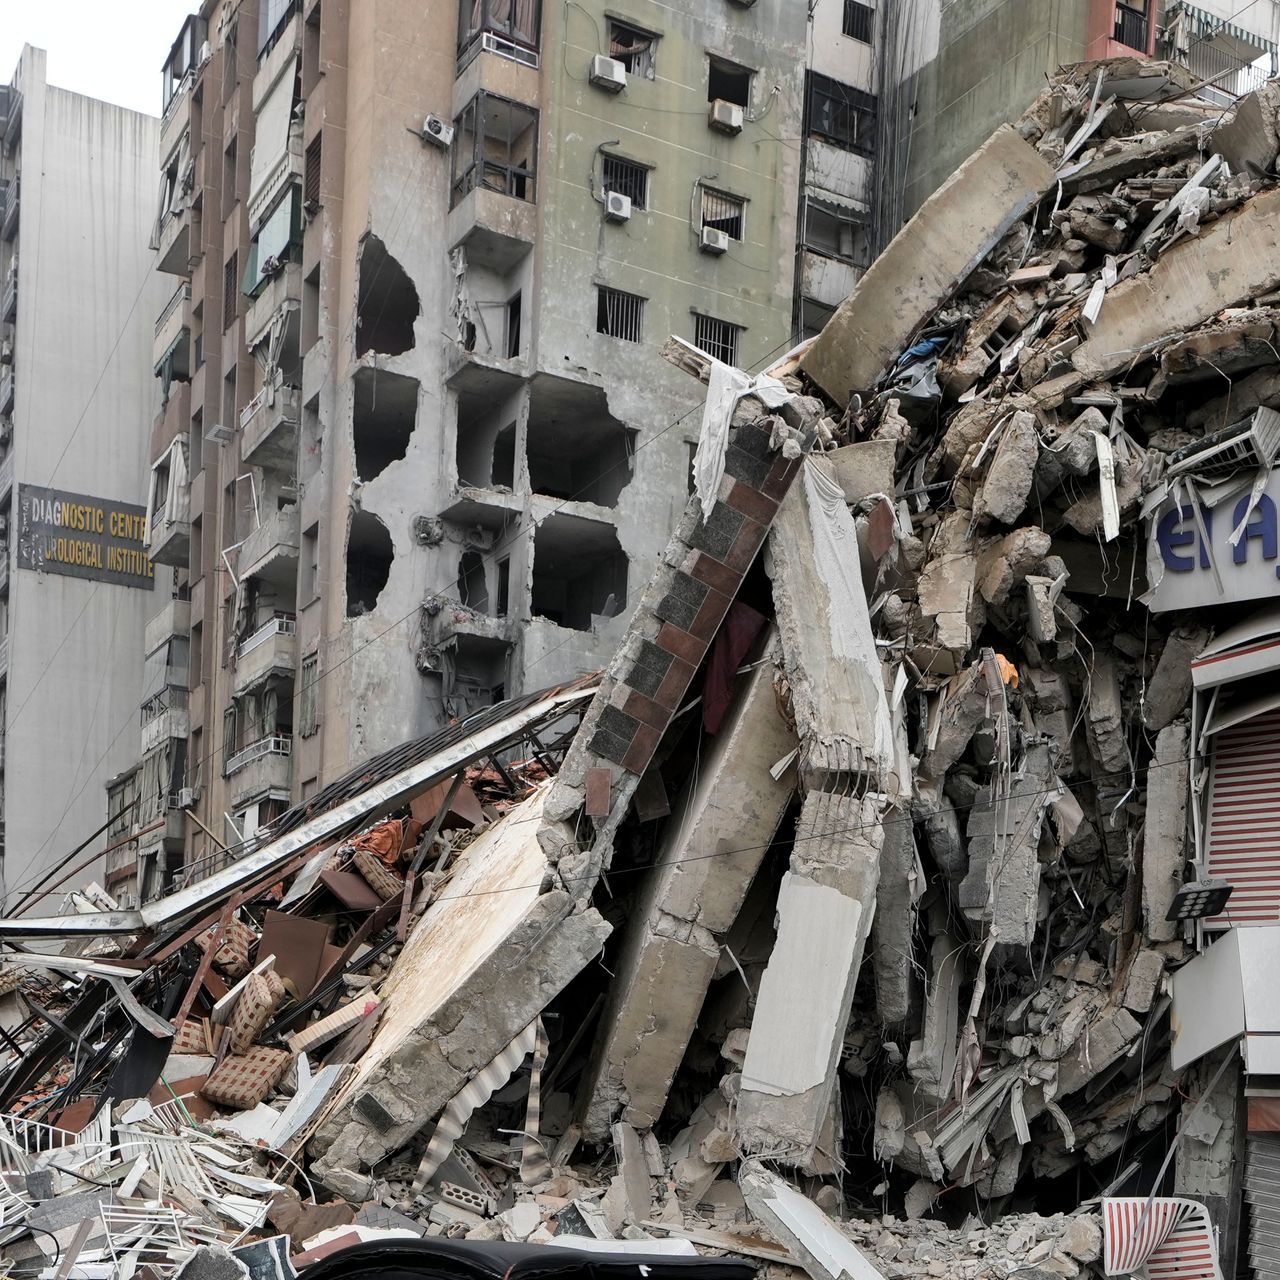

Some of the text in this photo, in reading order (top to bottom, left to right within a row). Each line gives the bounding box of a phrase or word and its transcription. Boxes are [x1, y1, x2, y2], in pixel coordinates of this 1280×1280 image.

[32, 497, 104, 534] DIAGNOSTIC
[110, 511, 148, 541] CENTE
[108, 546, 154, 577] INSTITUTE
